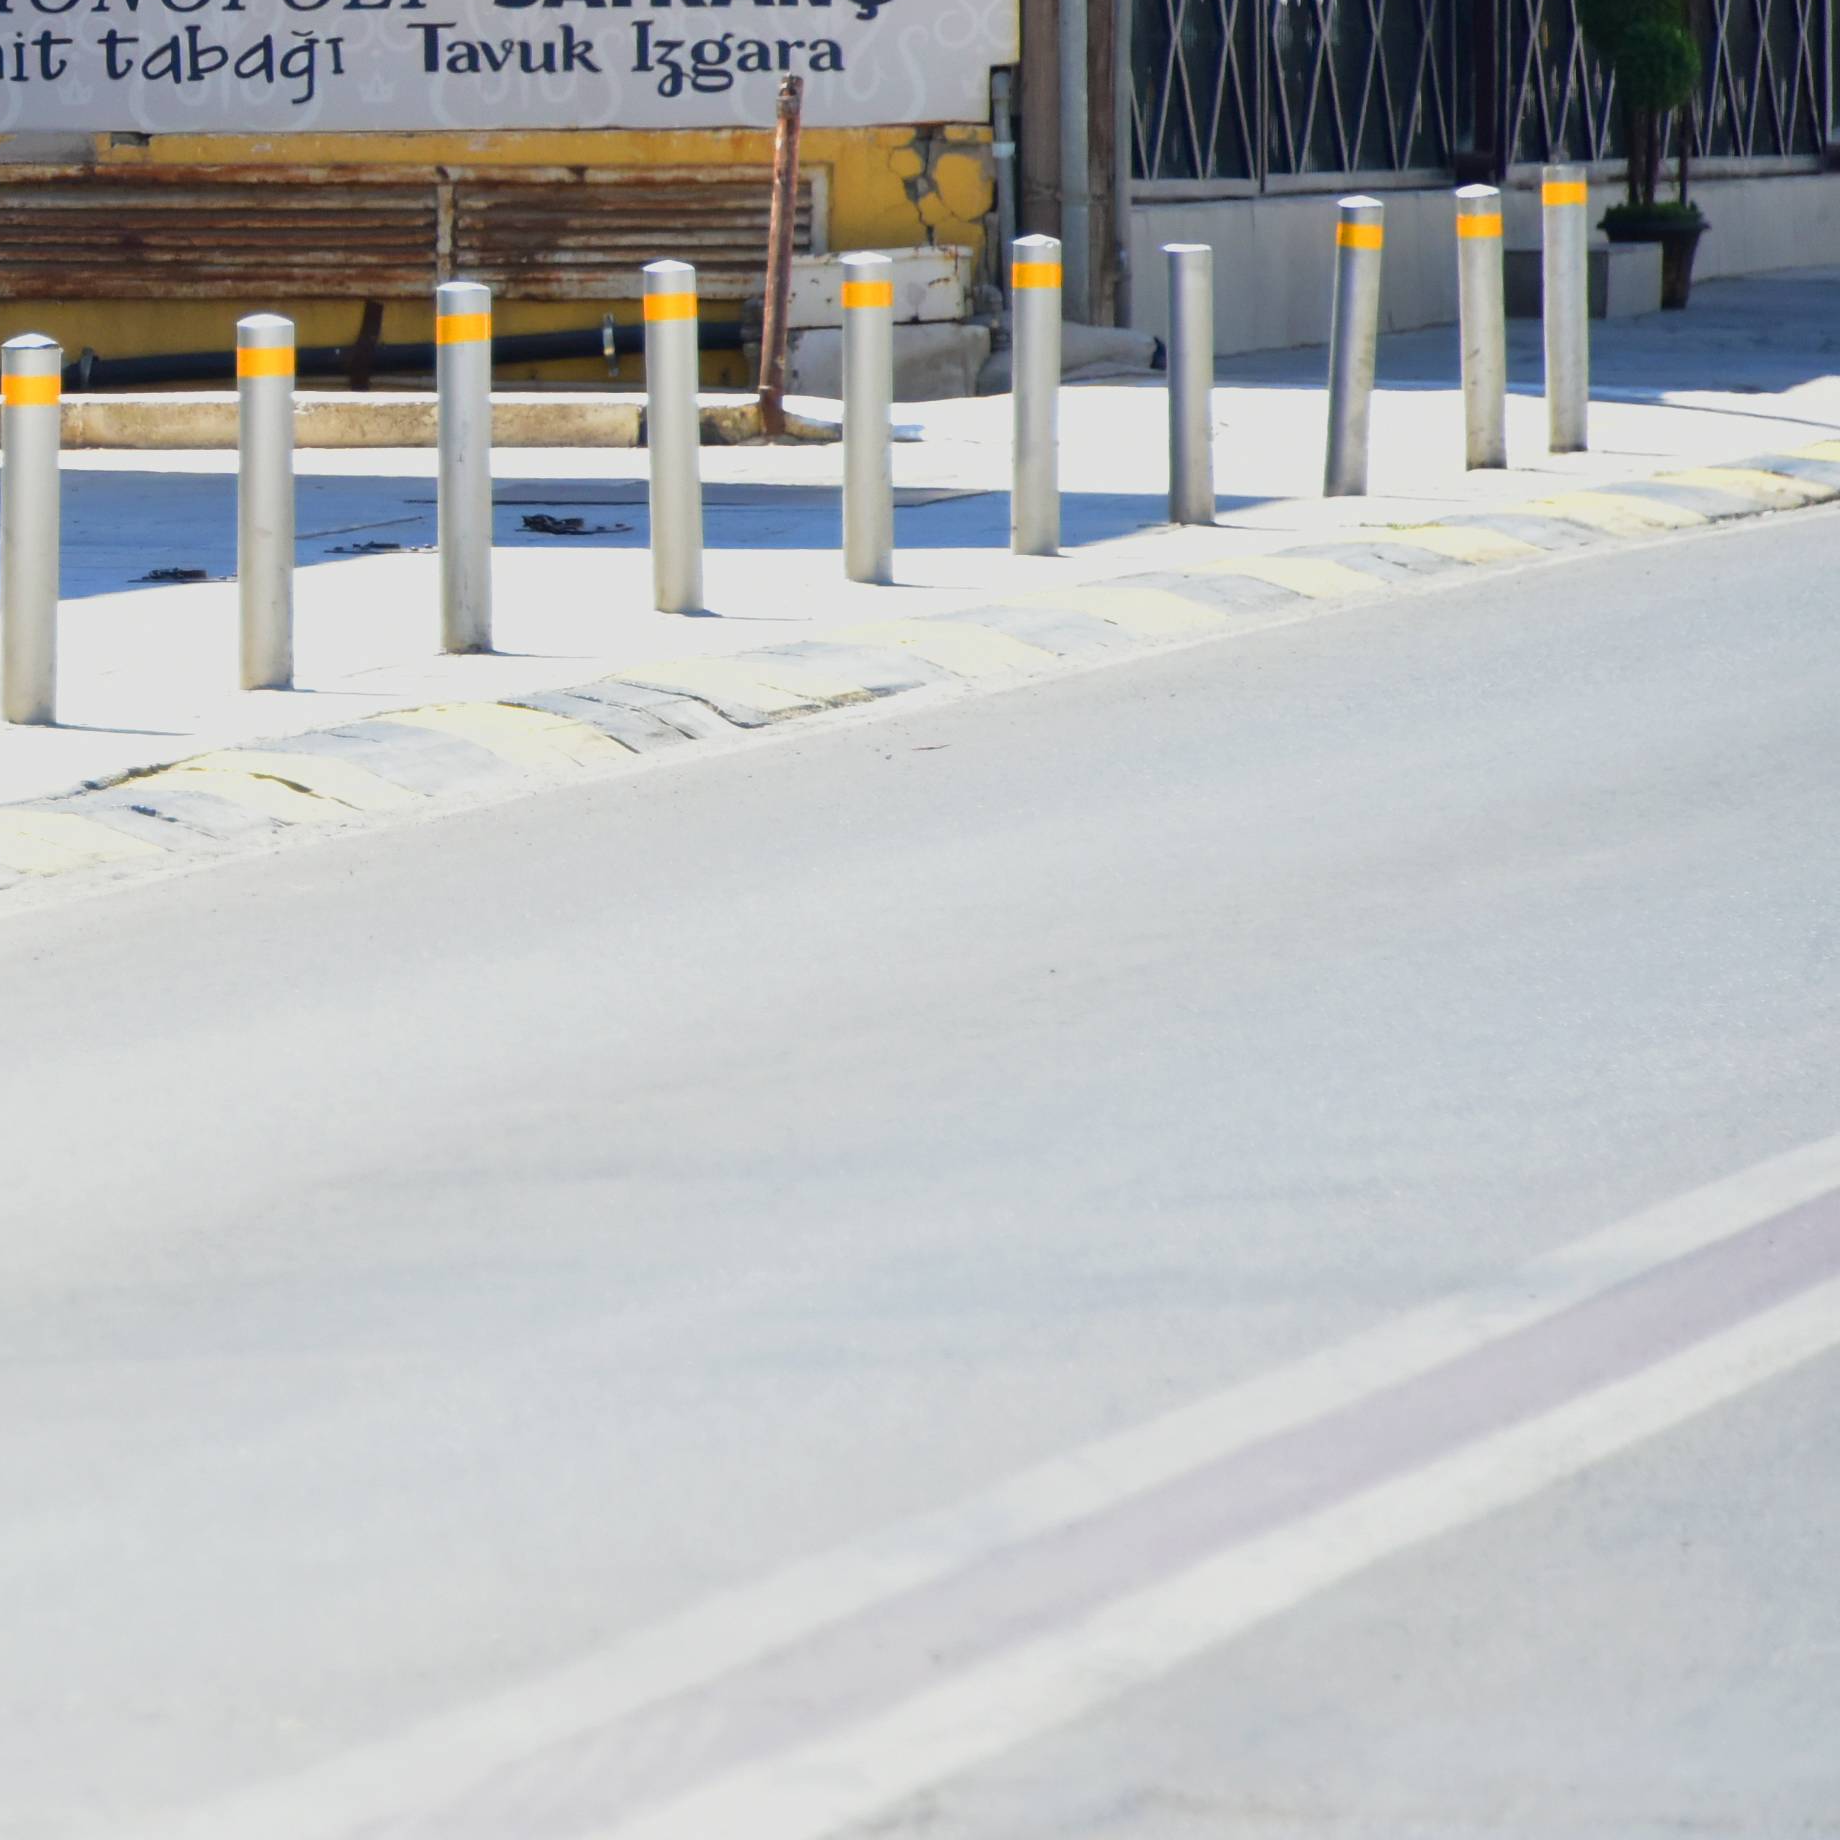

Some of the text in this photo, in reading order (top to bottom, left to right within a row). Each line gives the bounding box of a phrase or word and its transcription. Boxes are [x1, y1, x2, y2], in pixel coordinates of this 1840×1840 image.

[97, 24, 346, 105] tabağı
[406, 21, 603, 74] Tavuk
[631, 19, 846, 98] Izgara
